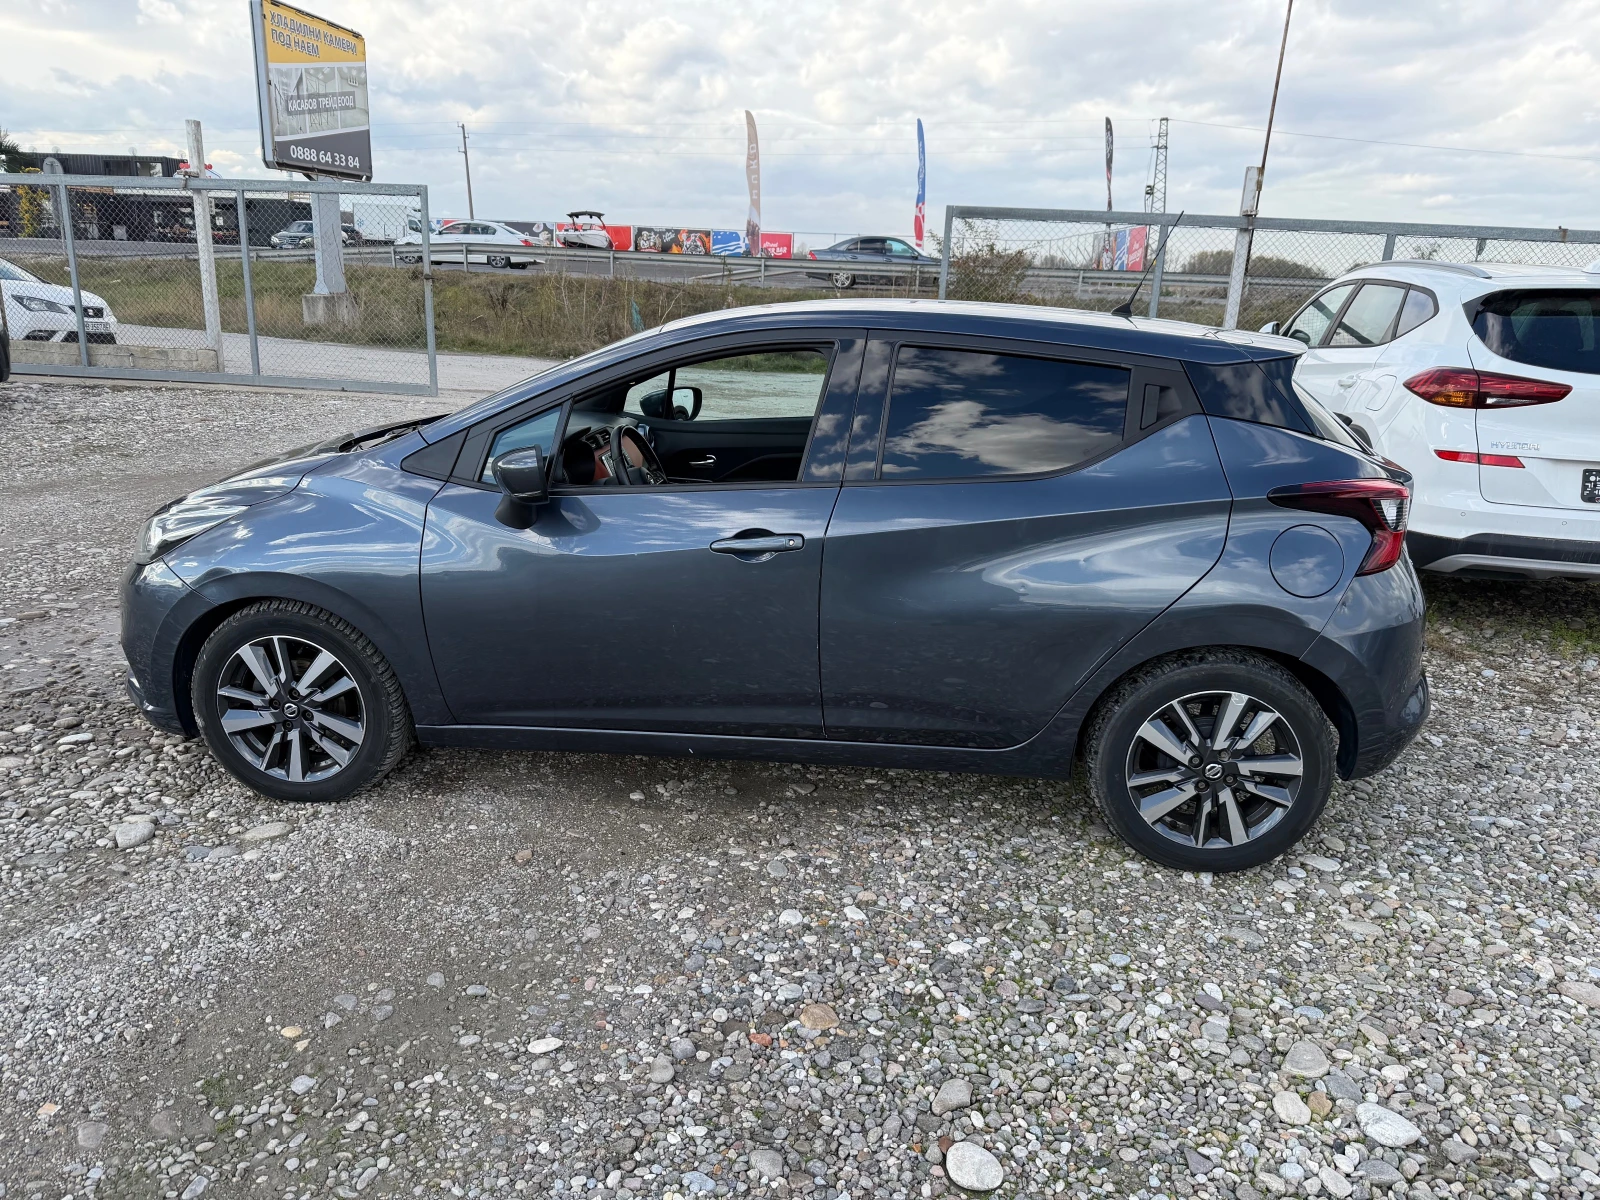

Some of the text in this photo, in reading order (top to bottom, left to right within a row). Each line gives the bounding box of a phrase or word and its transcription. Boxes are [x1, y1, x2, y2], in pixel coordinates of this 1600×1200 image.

[269, 10, 358, 55] ХЛАДИЛНИ КАМЕРИ
[271, 28, 320, 58] ПОД НАЕМ
[288, 98, 317, 111] КАСАБОВ
[290, 145, 360, 169] 0888 64 33 84
[1490, 441, 1540, 451] HYUNDAI
